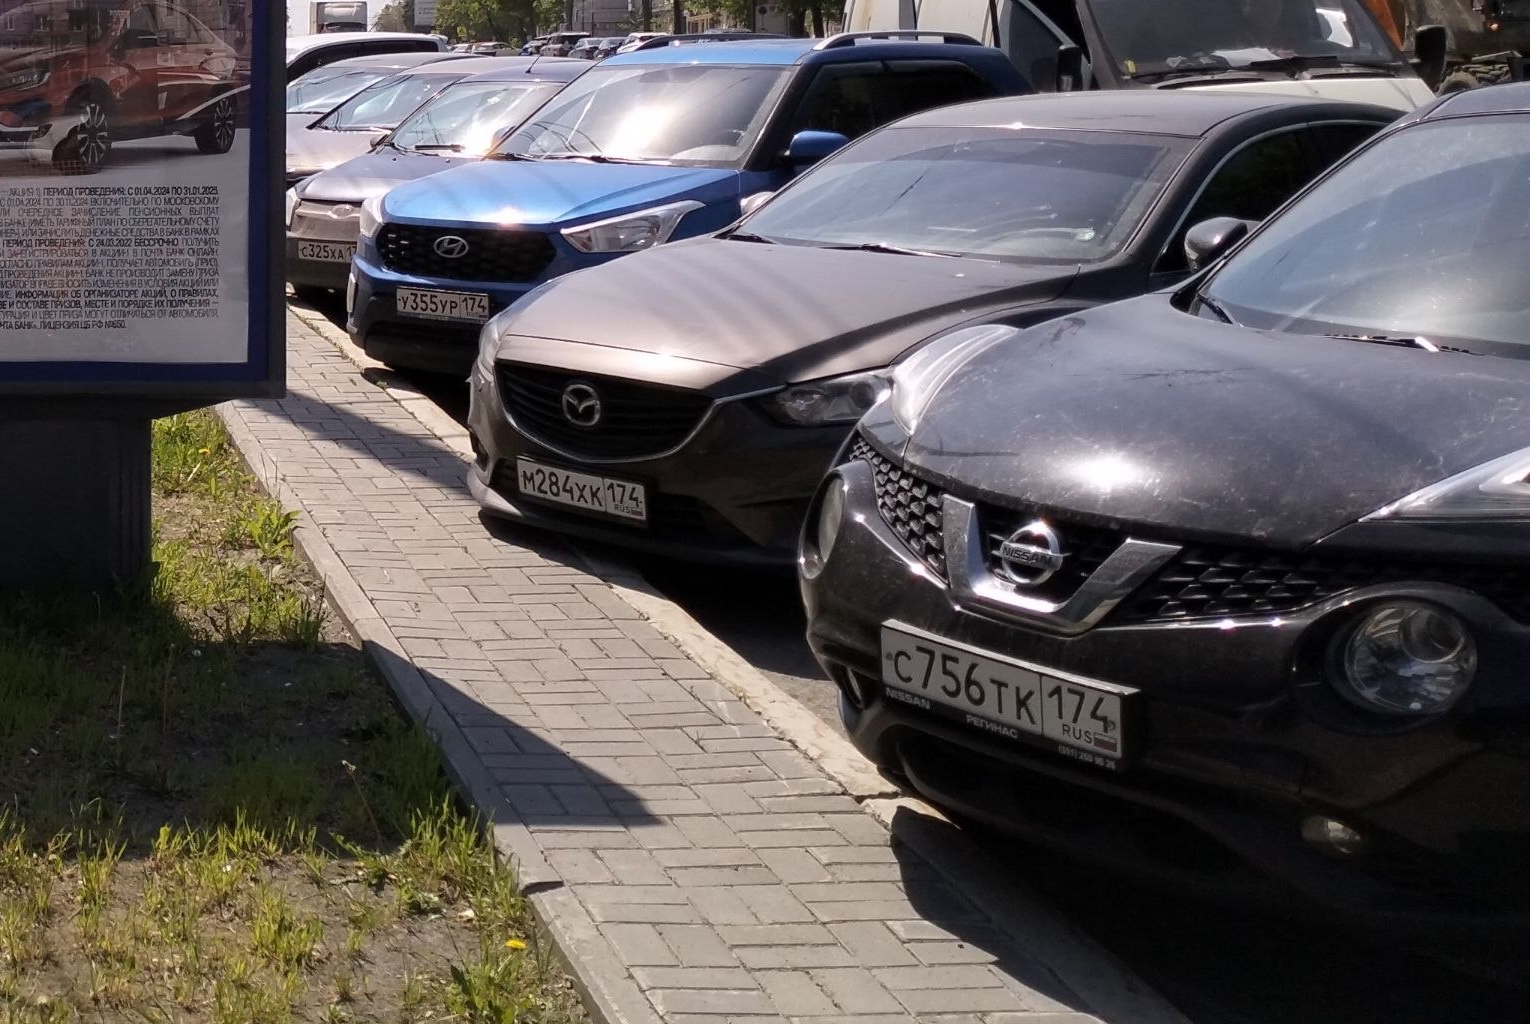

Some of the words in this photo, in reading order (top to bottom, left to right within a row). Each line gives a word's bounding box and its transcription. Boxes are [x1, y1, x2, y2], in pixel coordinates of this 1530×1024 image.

[461, 296, 486, 313] 174
[606, 482, 639, 508] 174
[1002, 546, 1053, 567] NISSAN
[886, 687, 931, 710] NISSAN
[893, 646, 1036, 725] С756ТК
[1047, 684, 1111, 733] 174
[966, 714, 1019, 740] РЕГИНАС
[1062, 723, 1094, 745] RUS
